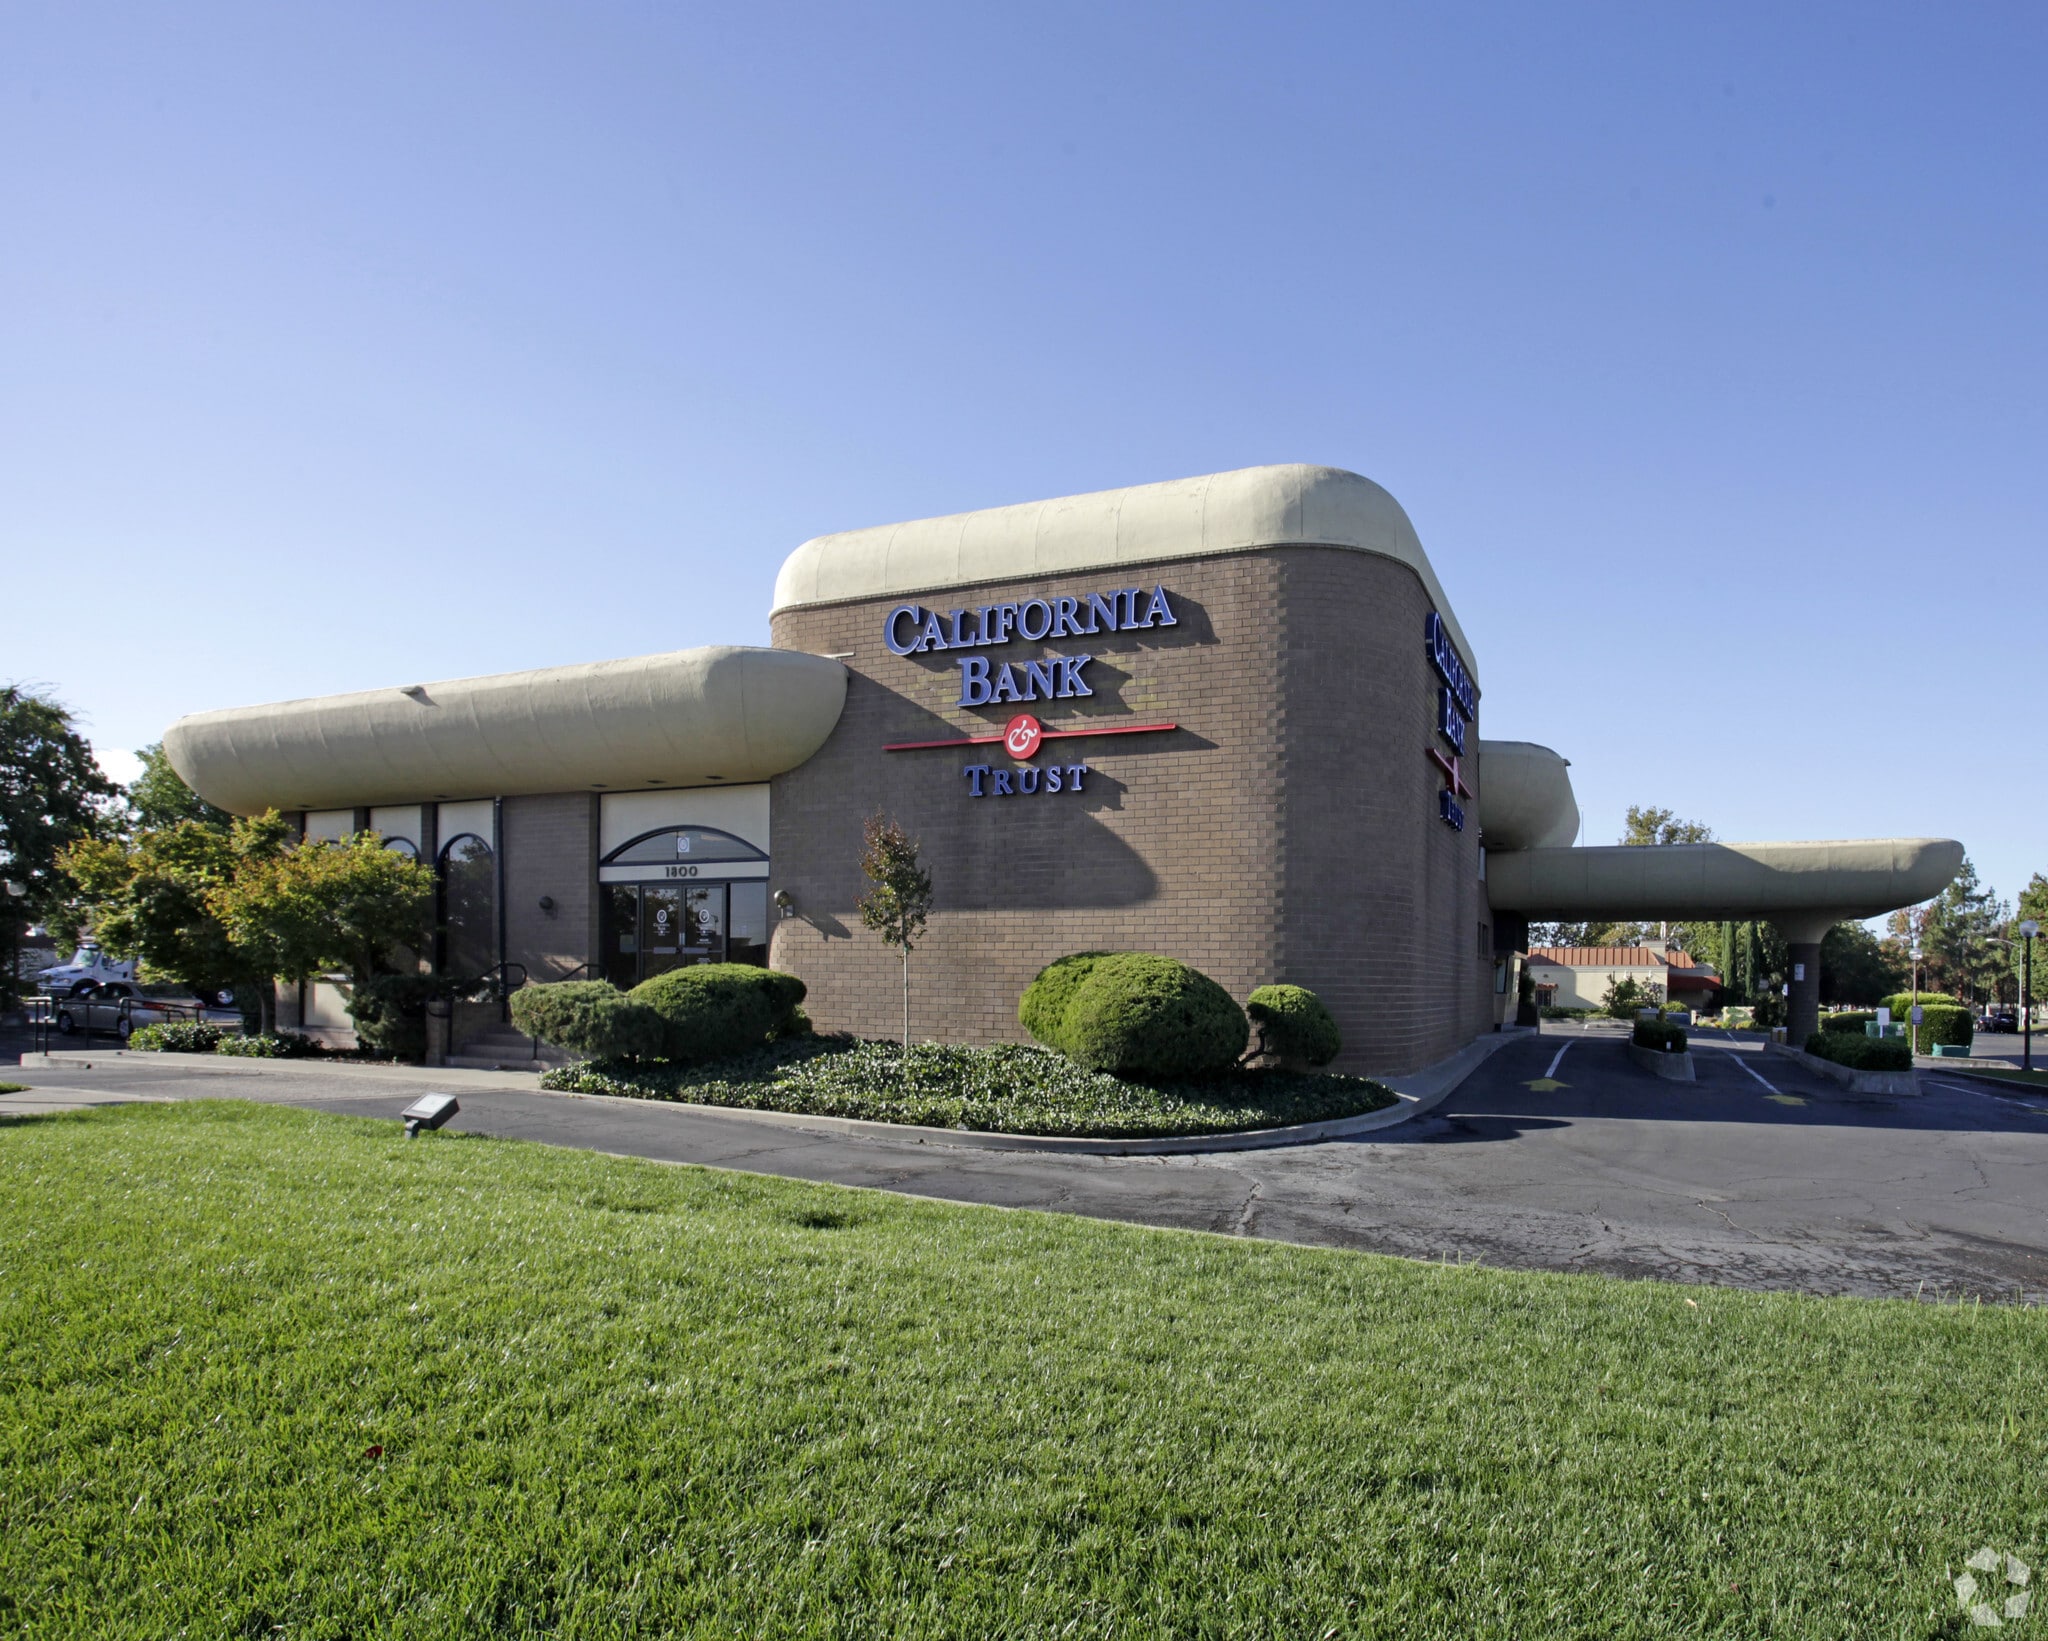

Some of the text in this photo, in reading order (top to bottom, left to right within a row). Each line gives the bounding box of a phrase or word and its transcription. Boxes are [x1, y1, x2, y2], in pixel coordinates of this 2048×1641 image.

[883, 584, 1177, 656] CALIFORNIA
[955, 655, 1093, 708] BANK
[1007, 719, 1038, 753] &
[963, 764, 1088, 798] TRUST
[665, 865, 698, 878] 1800
